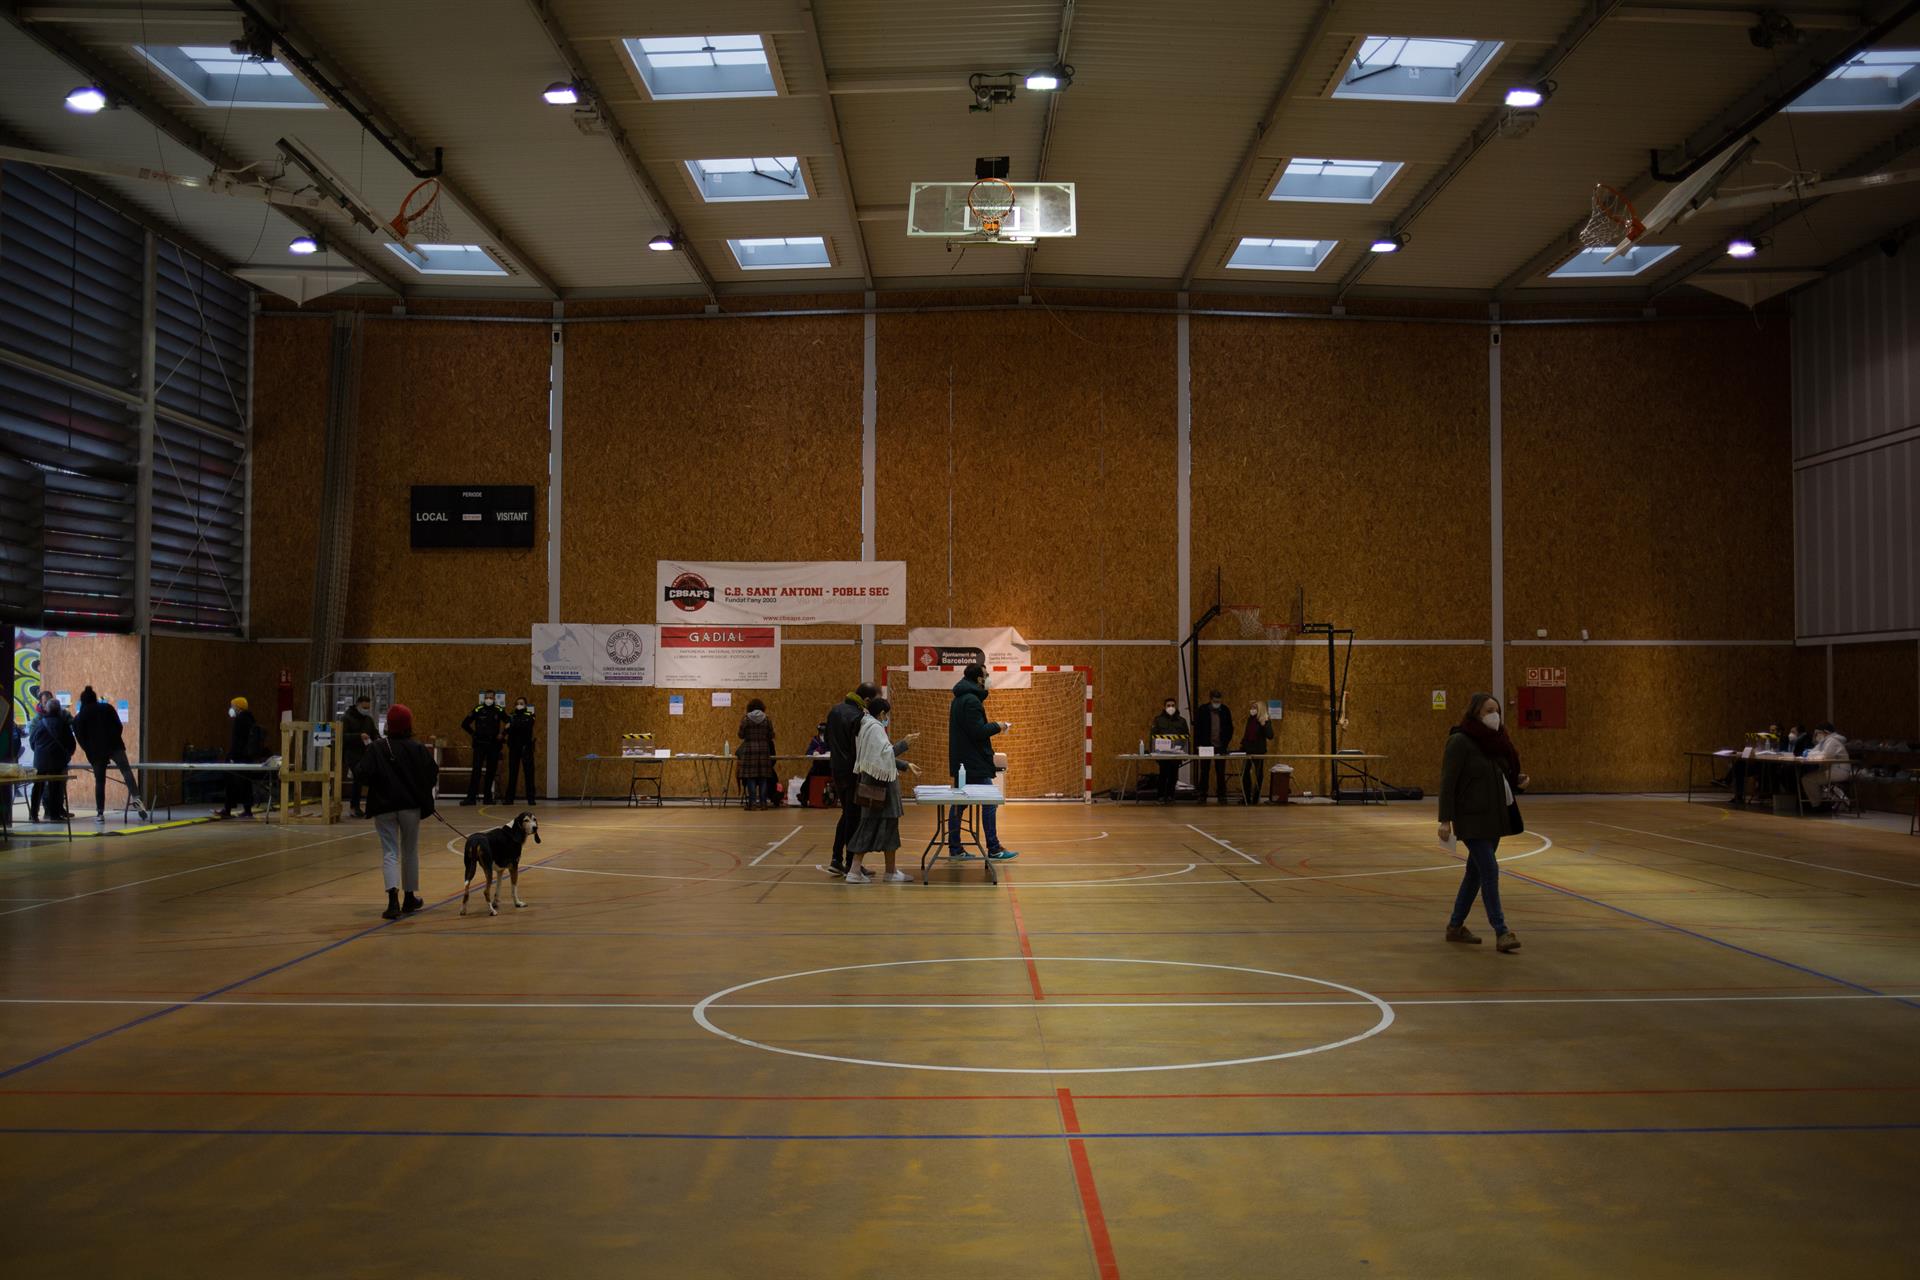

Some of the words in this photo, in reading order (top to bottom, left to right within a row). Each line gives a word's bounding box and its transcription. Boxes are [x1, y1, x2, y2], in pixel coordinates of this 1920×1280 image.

[416, 512, 449, 522] LOCAL
[496, 511, 529, 522] VISITANT
[669, 589, 710, 599] CBSAPS
[724, 587, 744, 597] C.B.
[746, 587, 777, 597] SANT
[780, 587, 823, 597] ANTONI
[832, 587, 866, 597] POBLE
[869, 587, 889, 597] SEC
[688, 631, 745, 643] GADIAL
[609, 650, 641, 665] Barcelona
